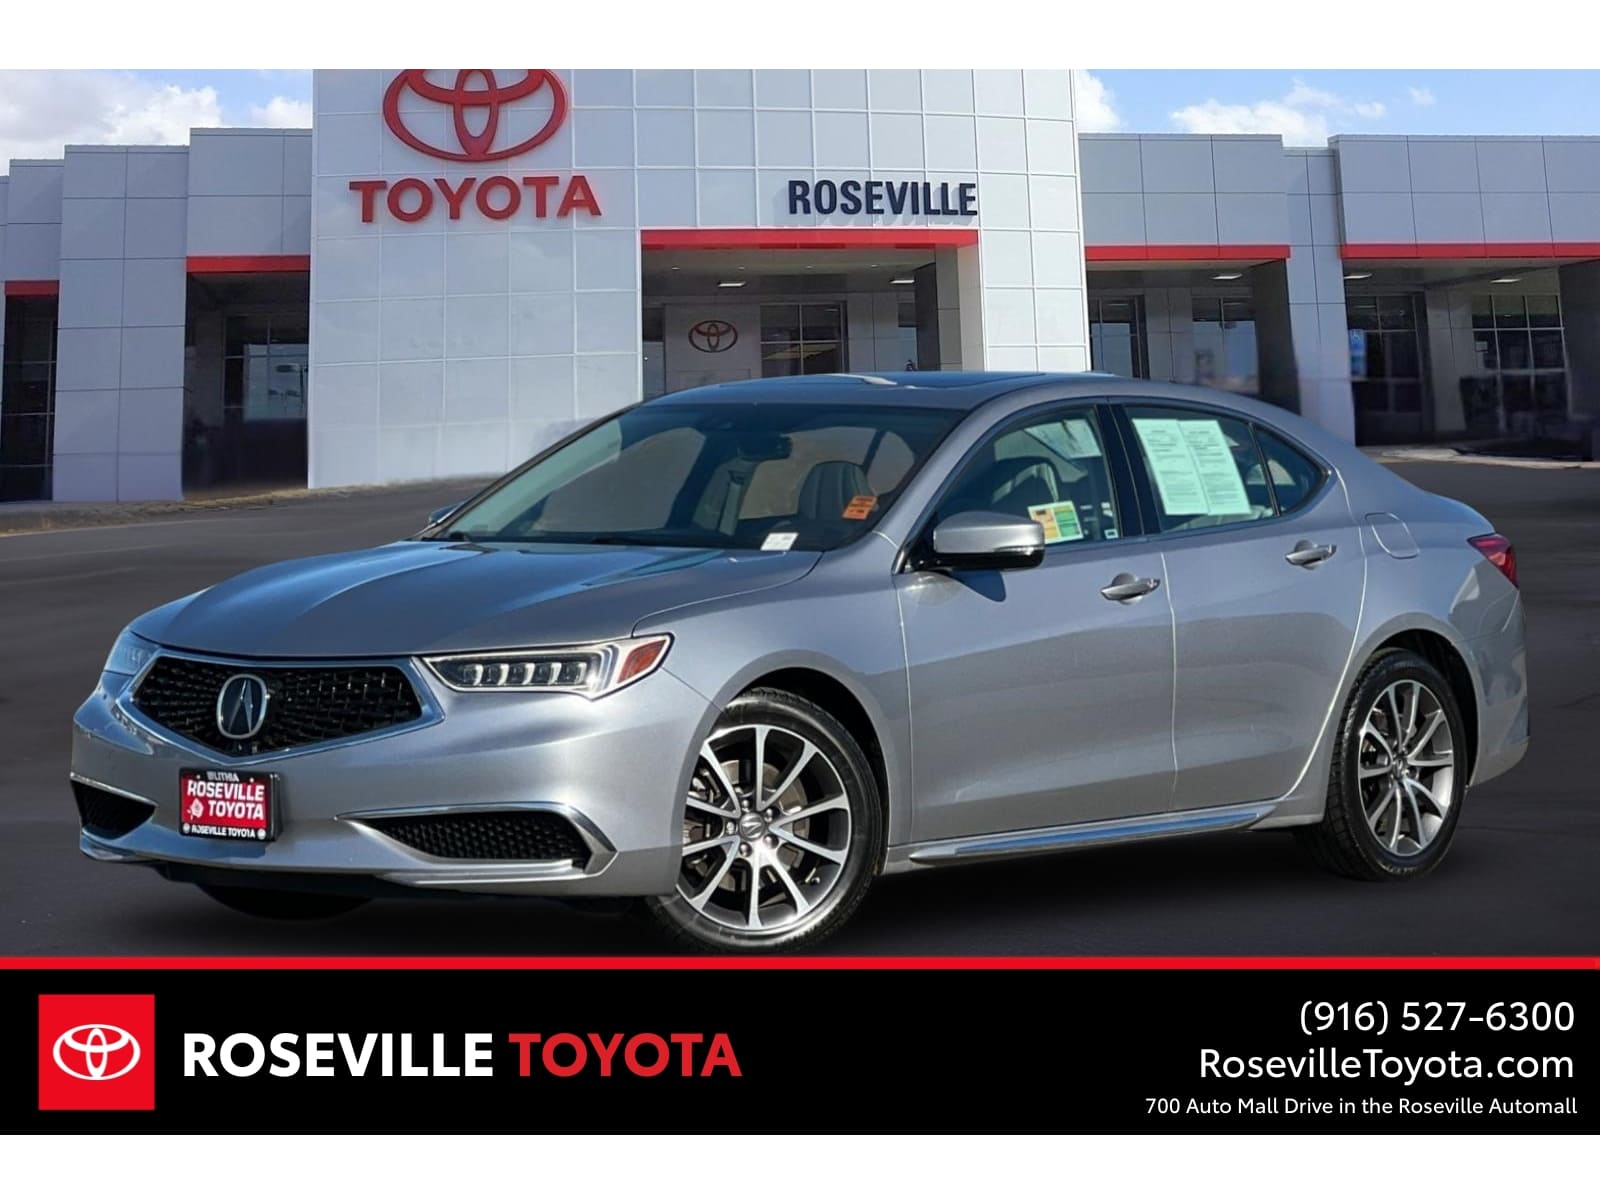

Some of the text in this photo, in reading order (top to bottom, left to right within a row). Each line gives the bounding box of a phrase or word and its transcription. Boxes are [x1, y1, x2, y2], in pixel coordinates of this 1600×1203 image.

[349, 175, 602, 223] TOYOTA
[788, 180, 978, 217] ROSEVILLE
[187, 780, 265, 802] ROSEVILLE
[207, 799, 265, 821] TOYOTA
[191, 825, 256, 838] ROSEVILLE TOYOTA
